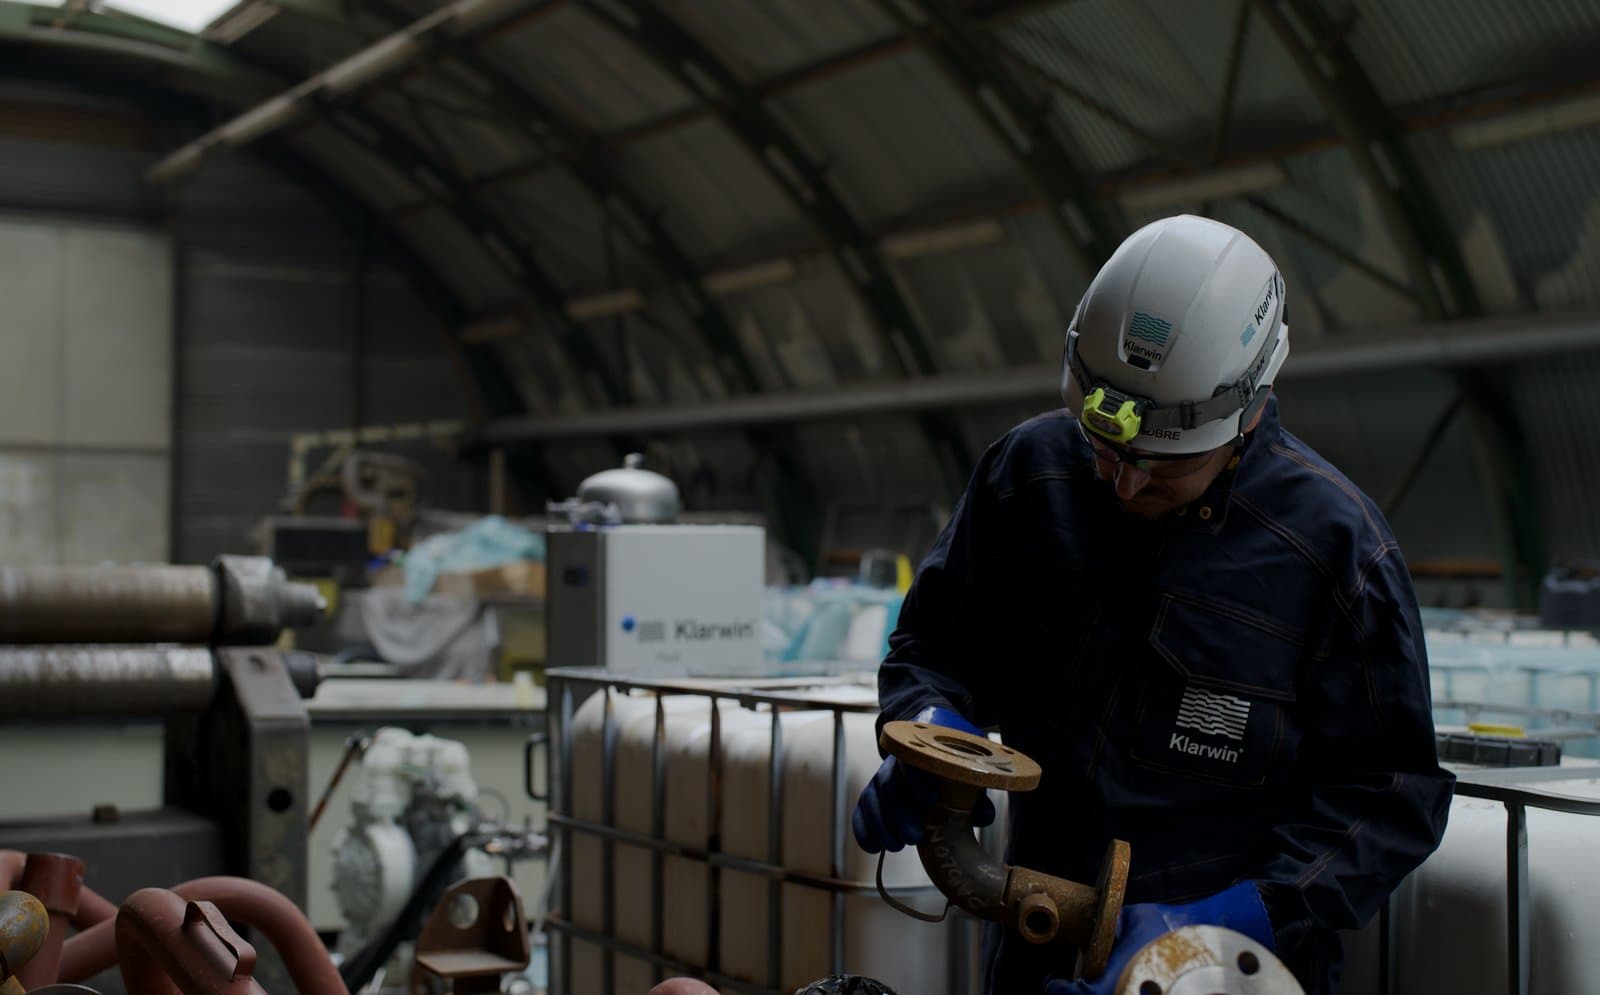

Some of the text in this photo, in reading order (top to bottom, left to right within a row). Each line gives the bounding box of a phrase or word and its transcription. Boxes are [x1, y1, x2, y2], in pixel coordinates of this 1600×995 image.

[1123, 339, 1162, 361] Klarwin
[674, 619, 754, 641] Klarwin
[1168, 732, 1240, 763] Klarwin
